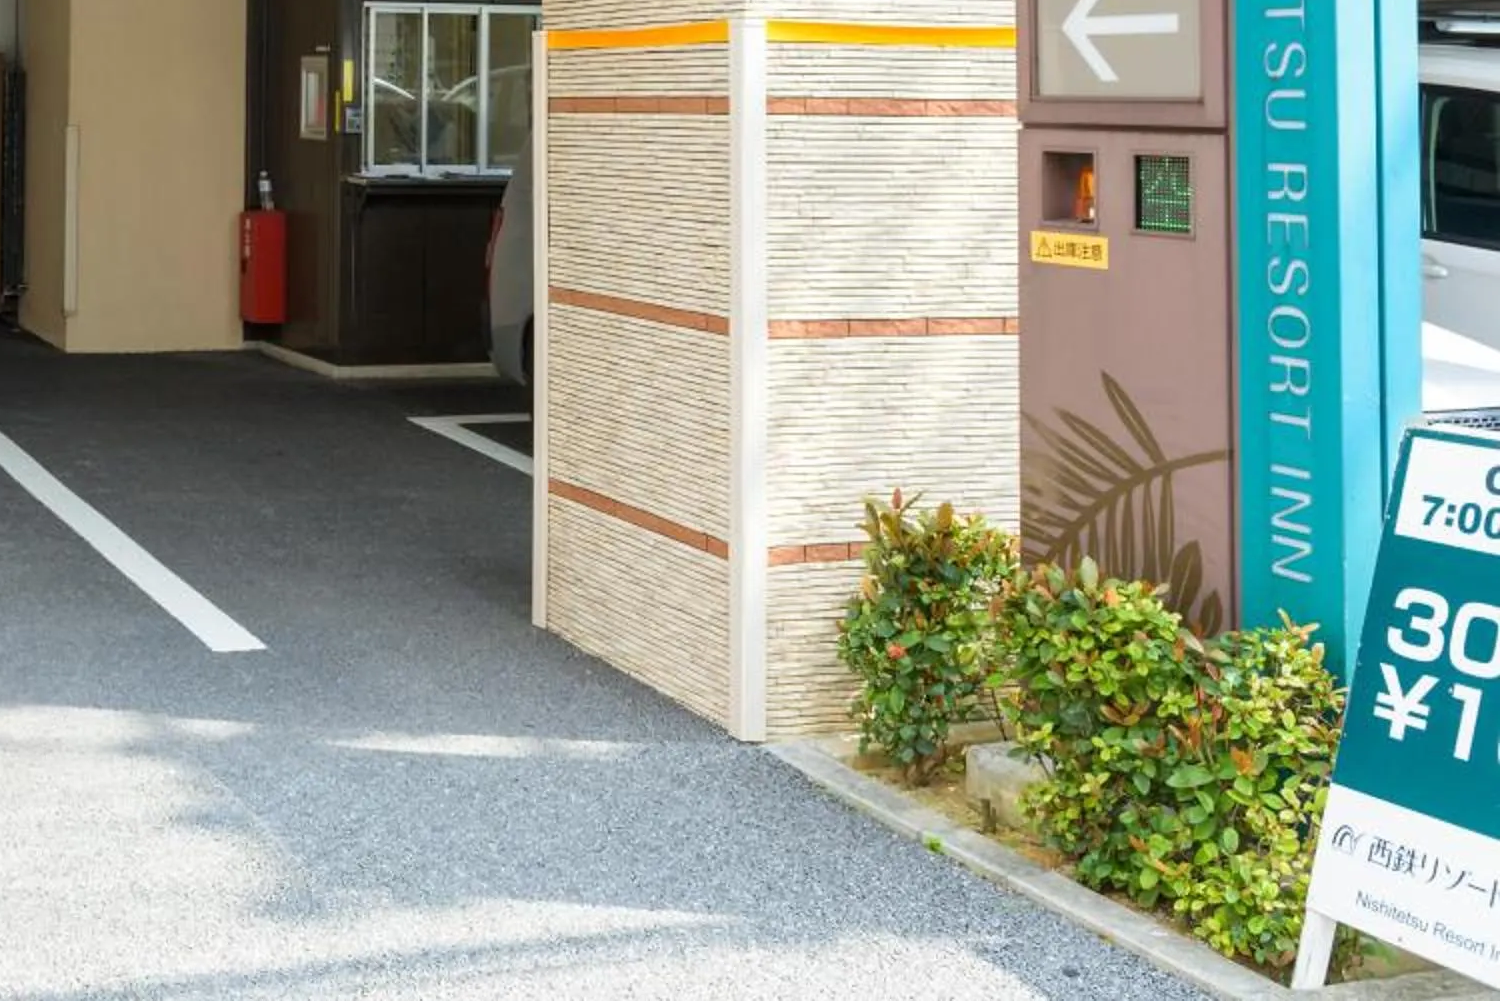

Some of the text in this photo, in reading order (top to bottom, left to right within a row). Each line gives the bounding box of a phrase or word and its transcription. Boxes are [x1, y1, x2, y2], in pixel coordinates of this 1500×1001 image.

[1266, 160, 1313, 438] RESORT
[1268, 465, 1315, 583] INN
[1373, 661, 1500, 763] ¥1
[1355, 889, 1430, 933] Nishitetsu
[1432, 921, 1486, 957] Resort
